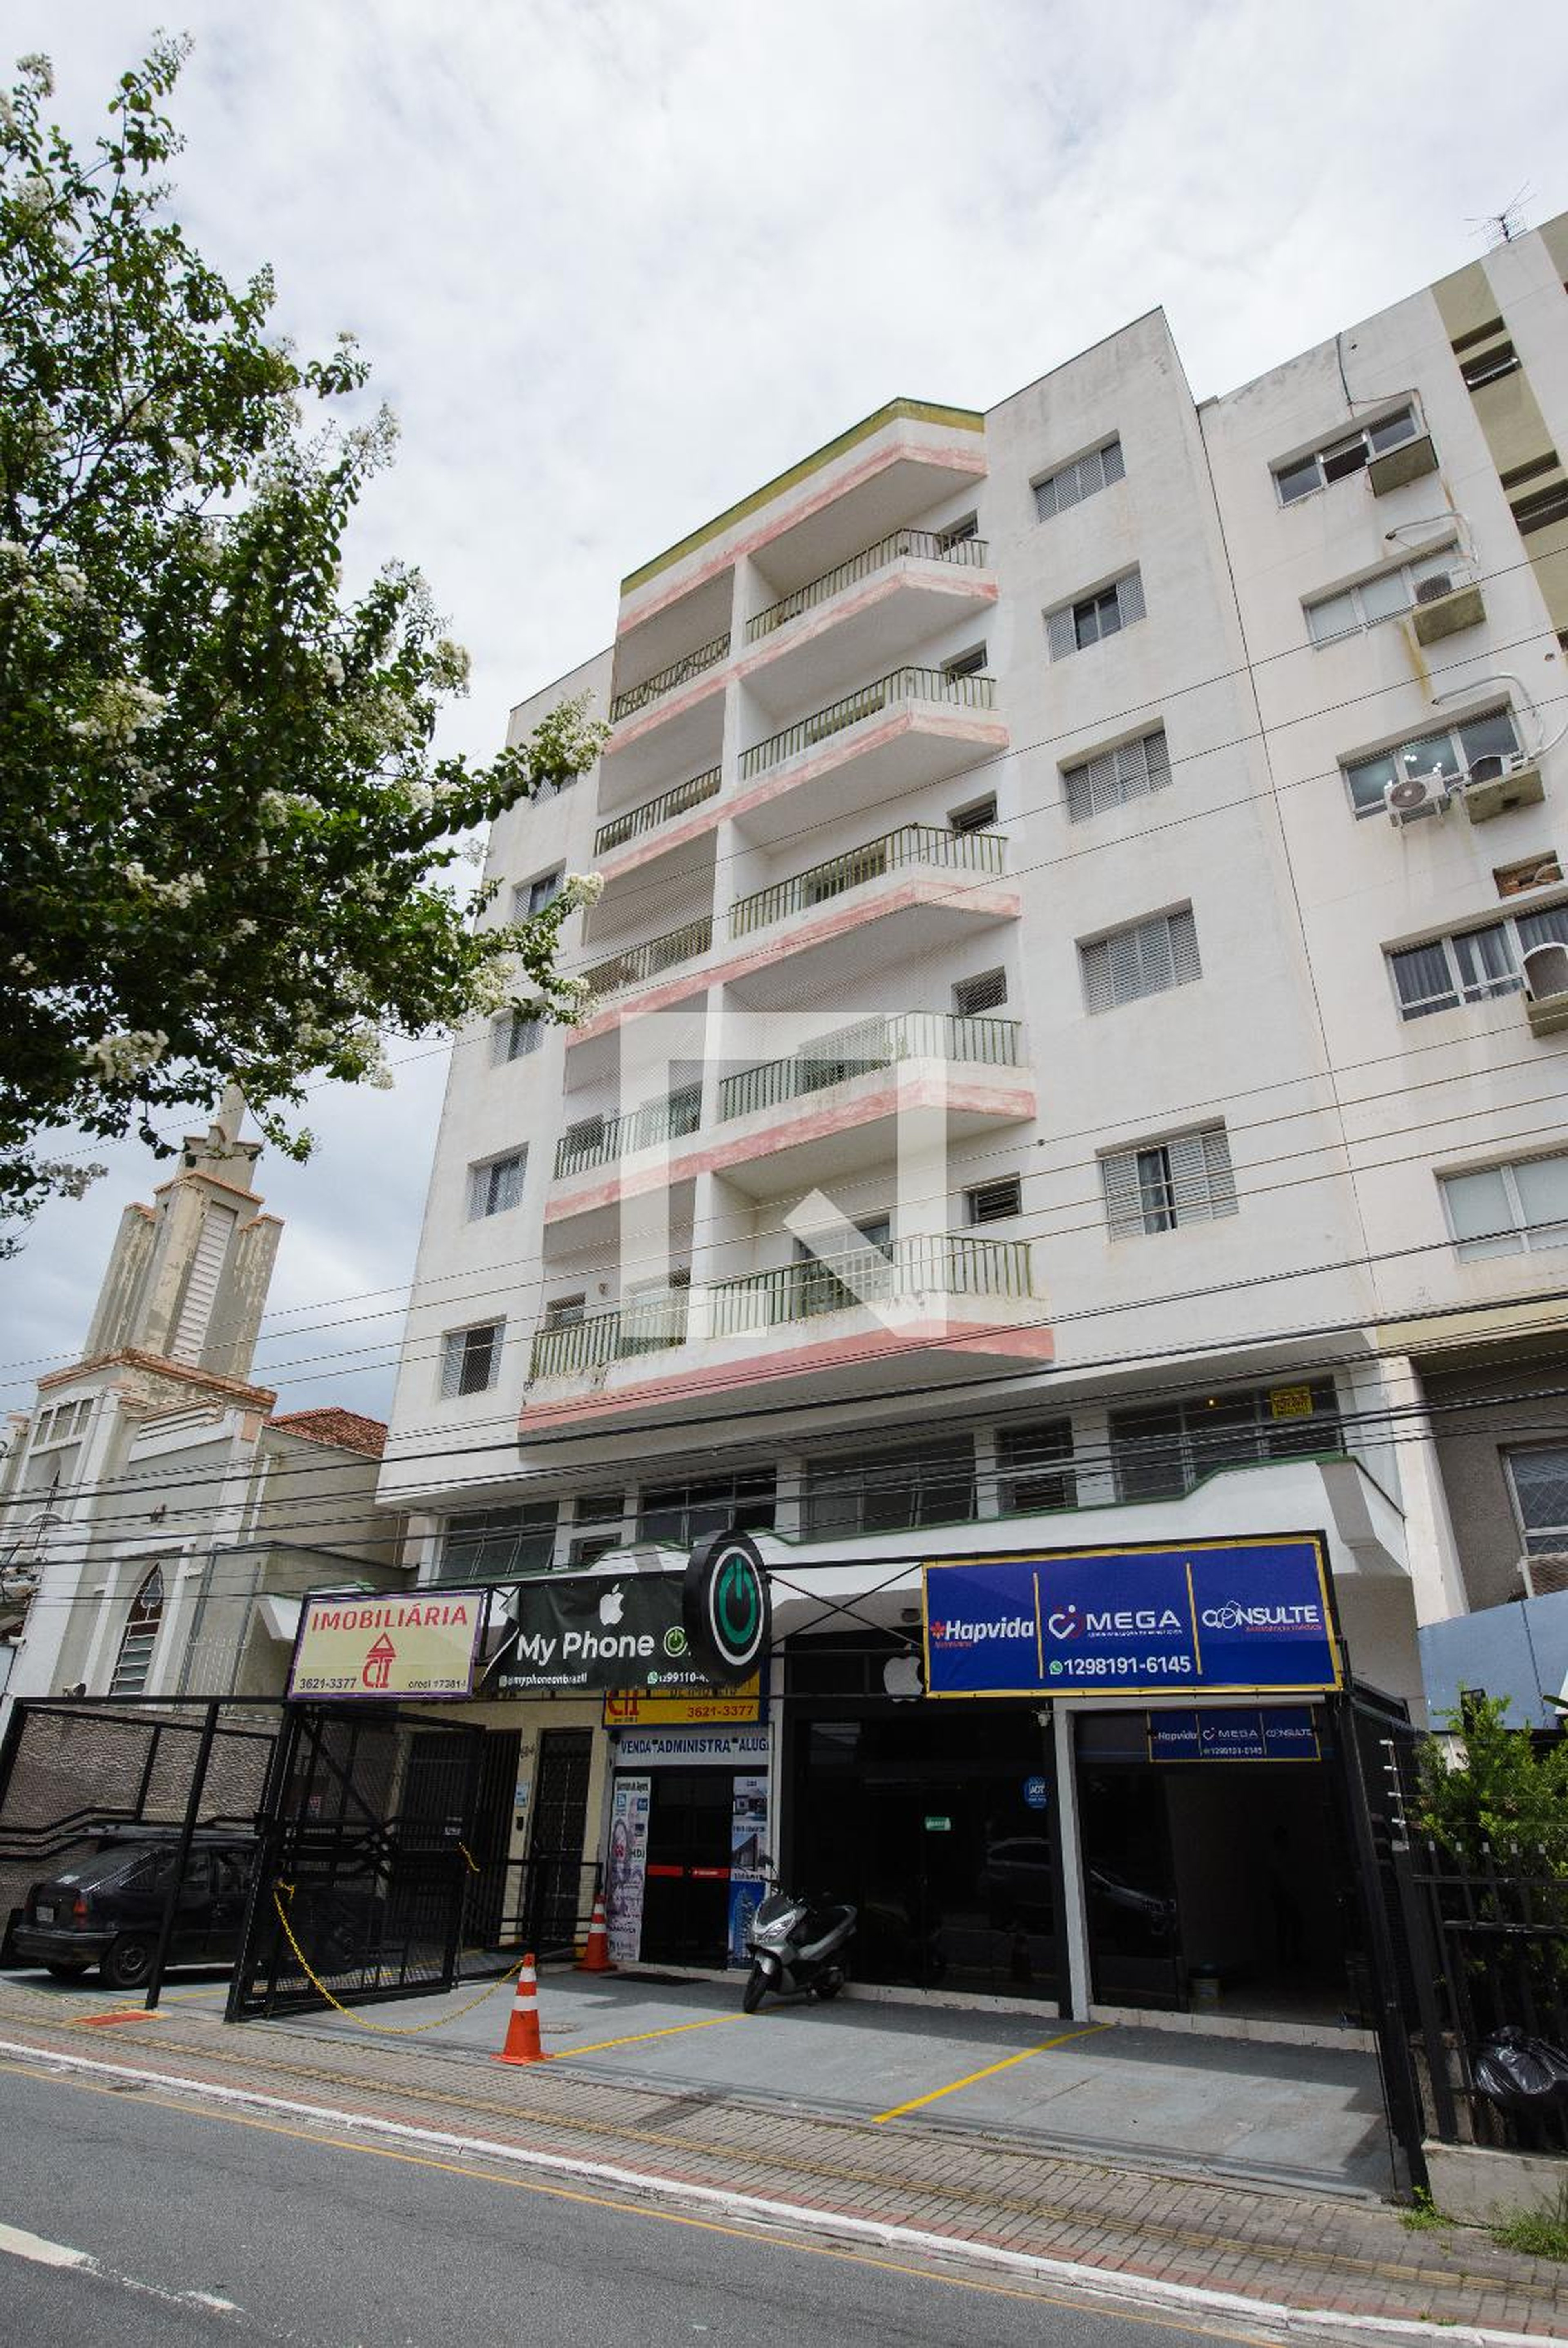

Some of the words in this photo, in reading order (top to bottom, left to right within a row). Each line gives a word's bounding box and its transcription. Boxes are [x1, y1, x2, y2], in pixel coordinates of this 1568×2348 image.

[312, 1603, 468, 1631] IMOBILIÁRIA
[1086, 1610, 1181, 1630] MEGA
[1202, 1604, 1319, 1629] CONSULTE
[945, 1617, 1034, 1643] Hapvida
[517, 1634, 557, 1666] My
[563, 1631, 655, 1659] Phone
[1063, 1655, 1191, 1675] 1298191-6145
[300, 1678, 357, 1690] 3621-3377
[687, 1706, 754, 1717] 3621-3377
[1218, 1729, 1258, 1738] MEGA
[620, 1739, 652, 1755] VENDA
[657, 1738, 731, 1753] ADMINISTRA
